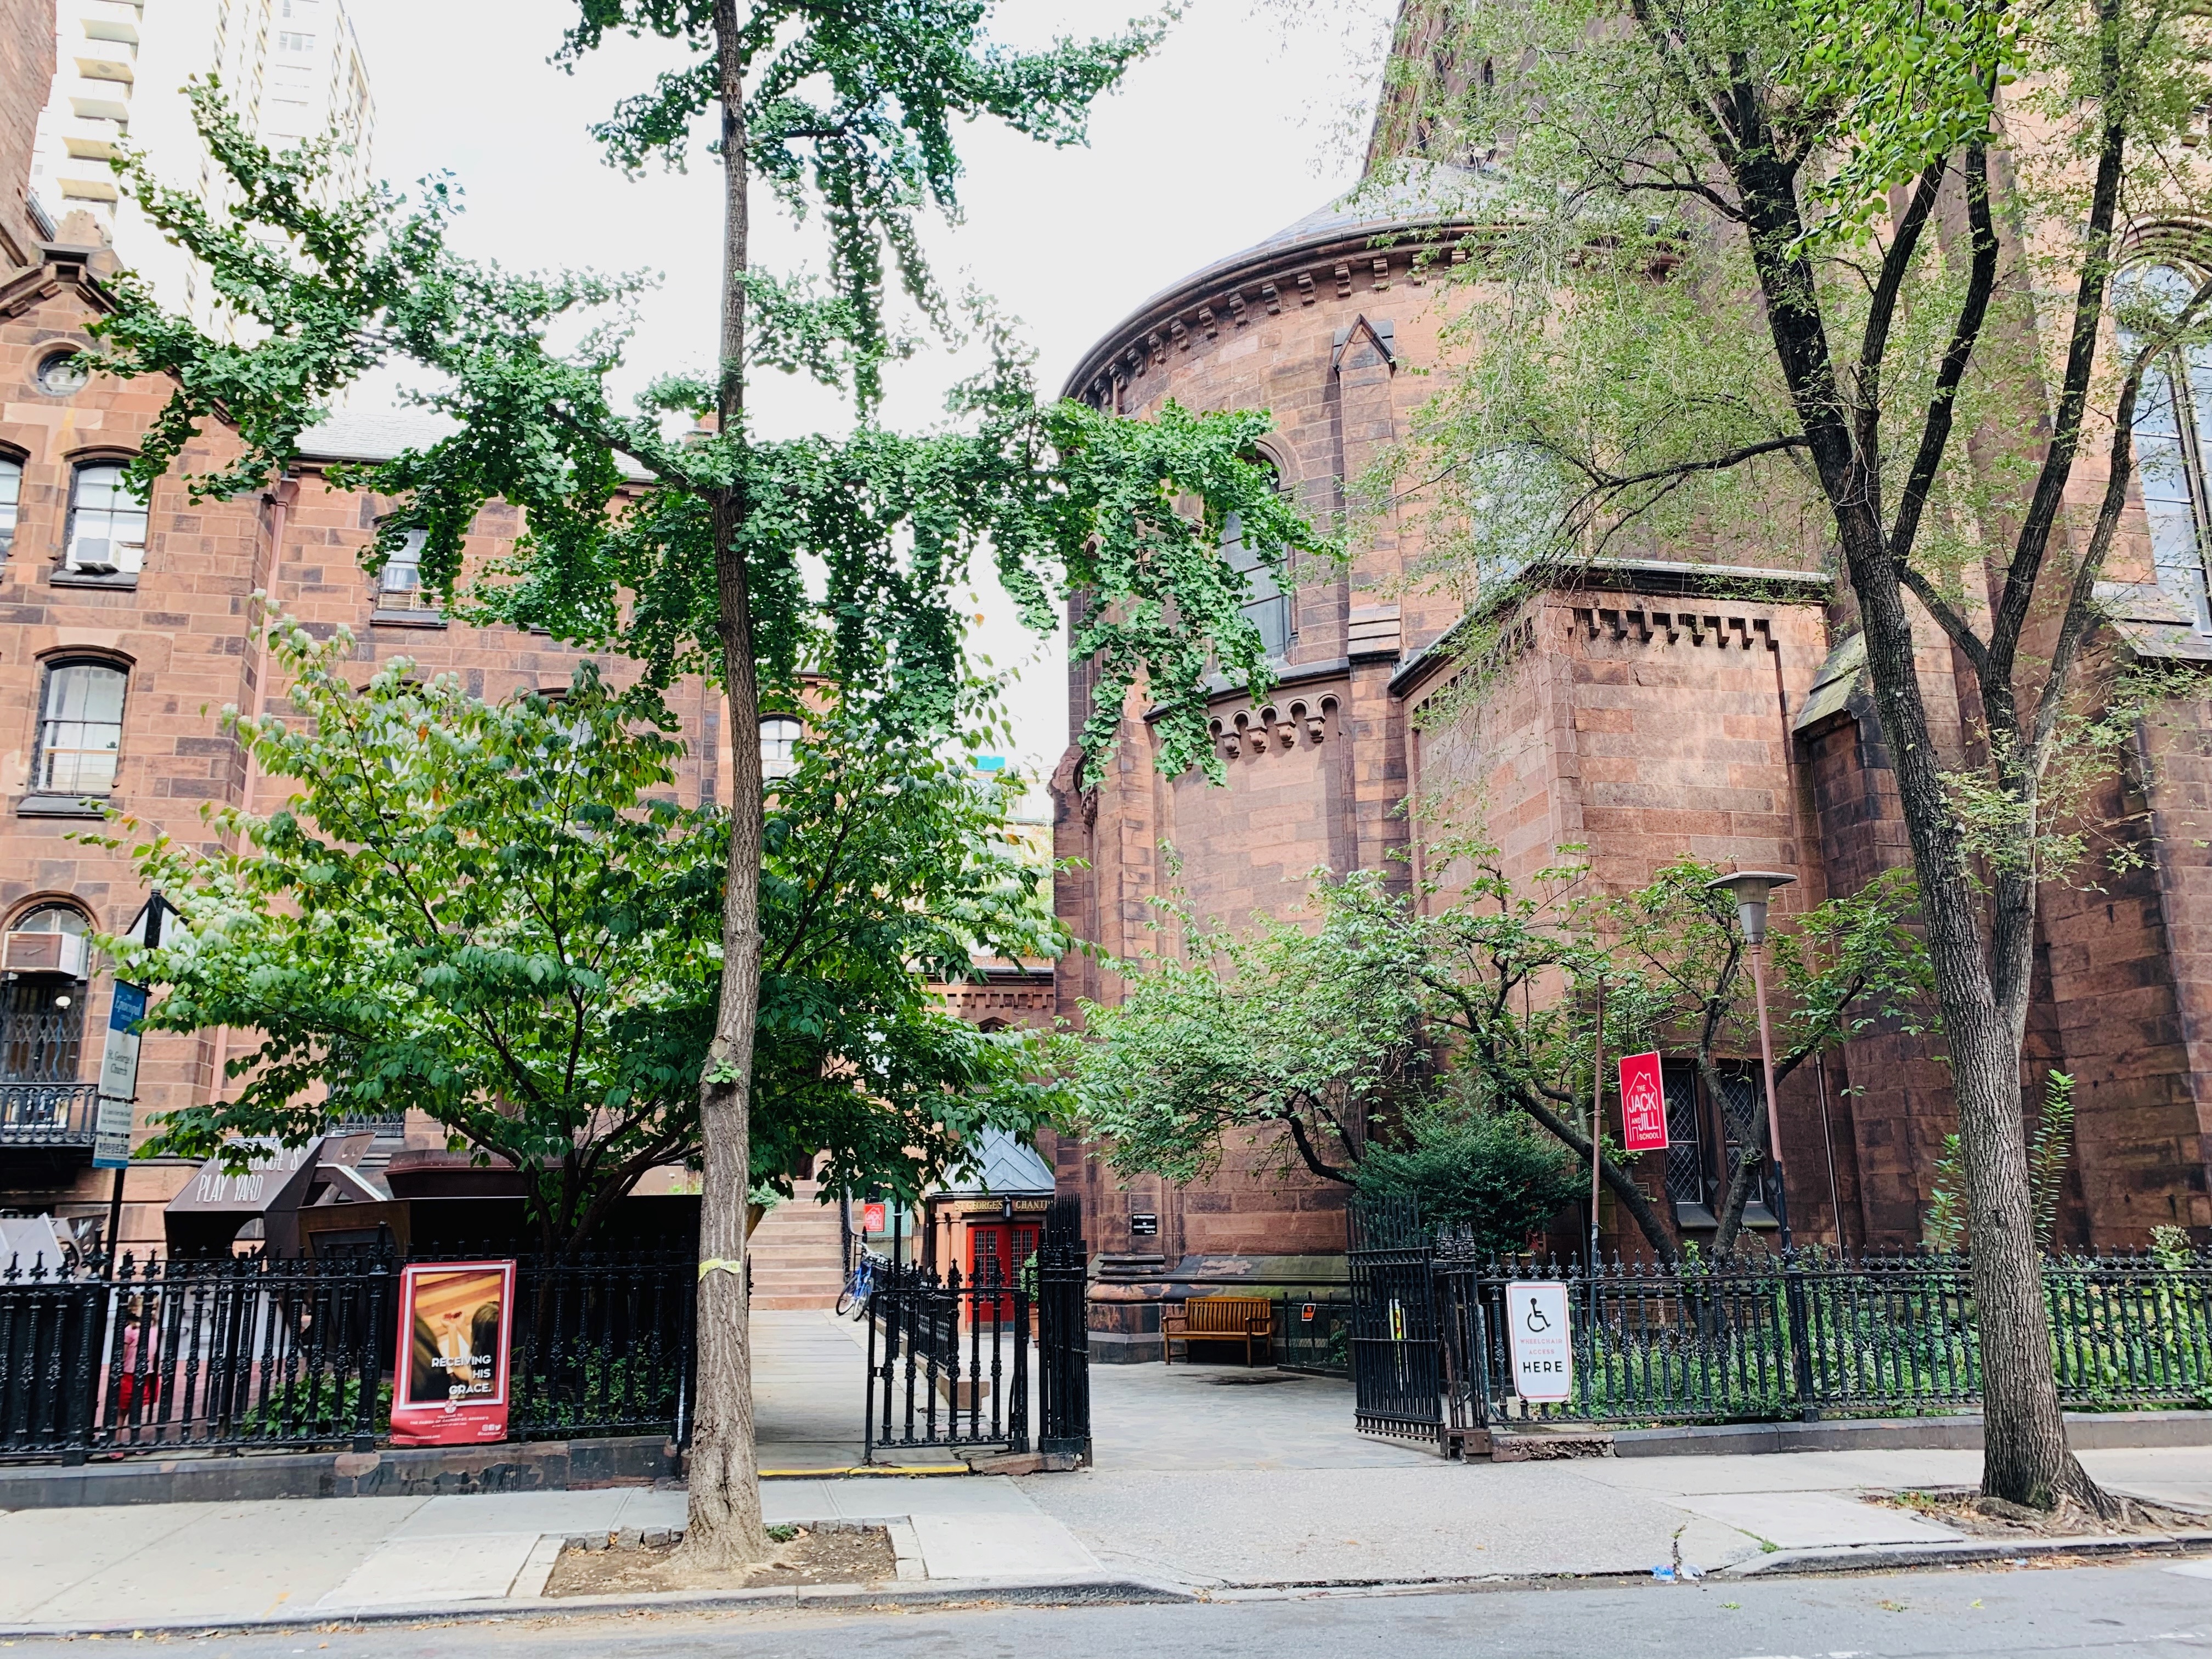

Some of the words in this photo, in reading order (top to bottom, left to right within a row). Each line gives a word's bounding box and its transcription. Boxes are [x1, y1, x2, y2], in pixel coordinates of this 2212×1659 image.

[111, 1063, 127, 1076] Church
[1629, 1092, 1656, 1113] JACK
[1632, 1116, 1641, 1125] AND
[1638, 1112, 1658, 1131] JILL
[1639, 1132, 1659, 1140] SCHOOL
[196, 1174, 228, 1203] PLAY
[234, 1174, 264, 1203] YARD
[955, 1202, 964, 1211] ST
[966, 1200, 1003, 1210] GEORGE'S
[432, 1355, 492, 1367] RECEIVING
[1523, 1361, 1563, 1373] HERE
[473, 1368, 491, 1379] HIS
[449, 1383, 492, 1395] GRACE.
